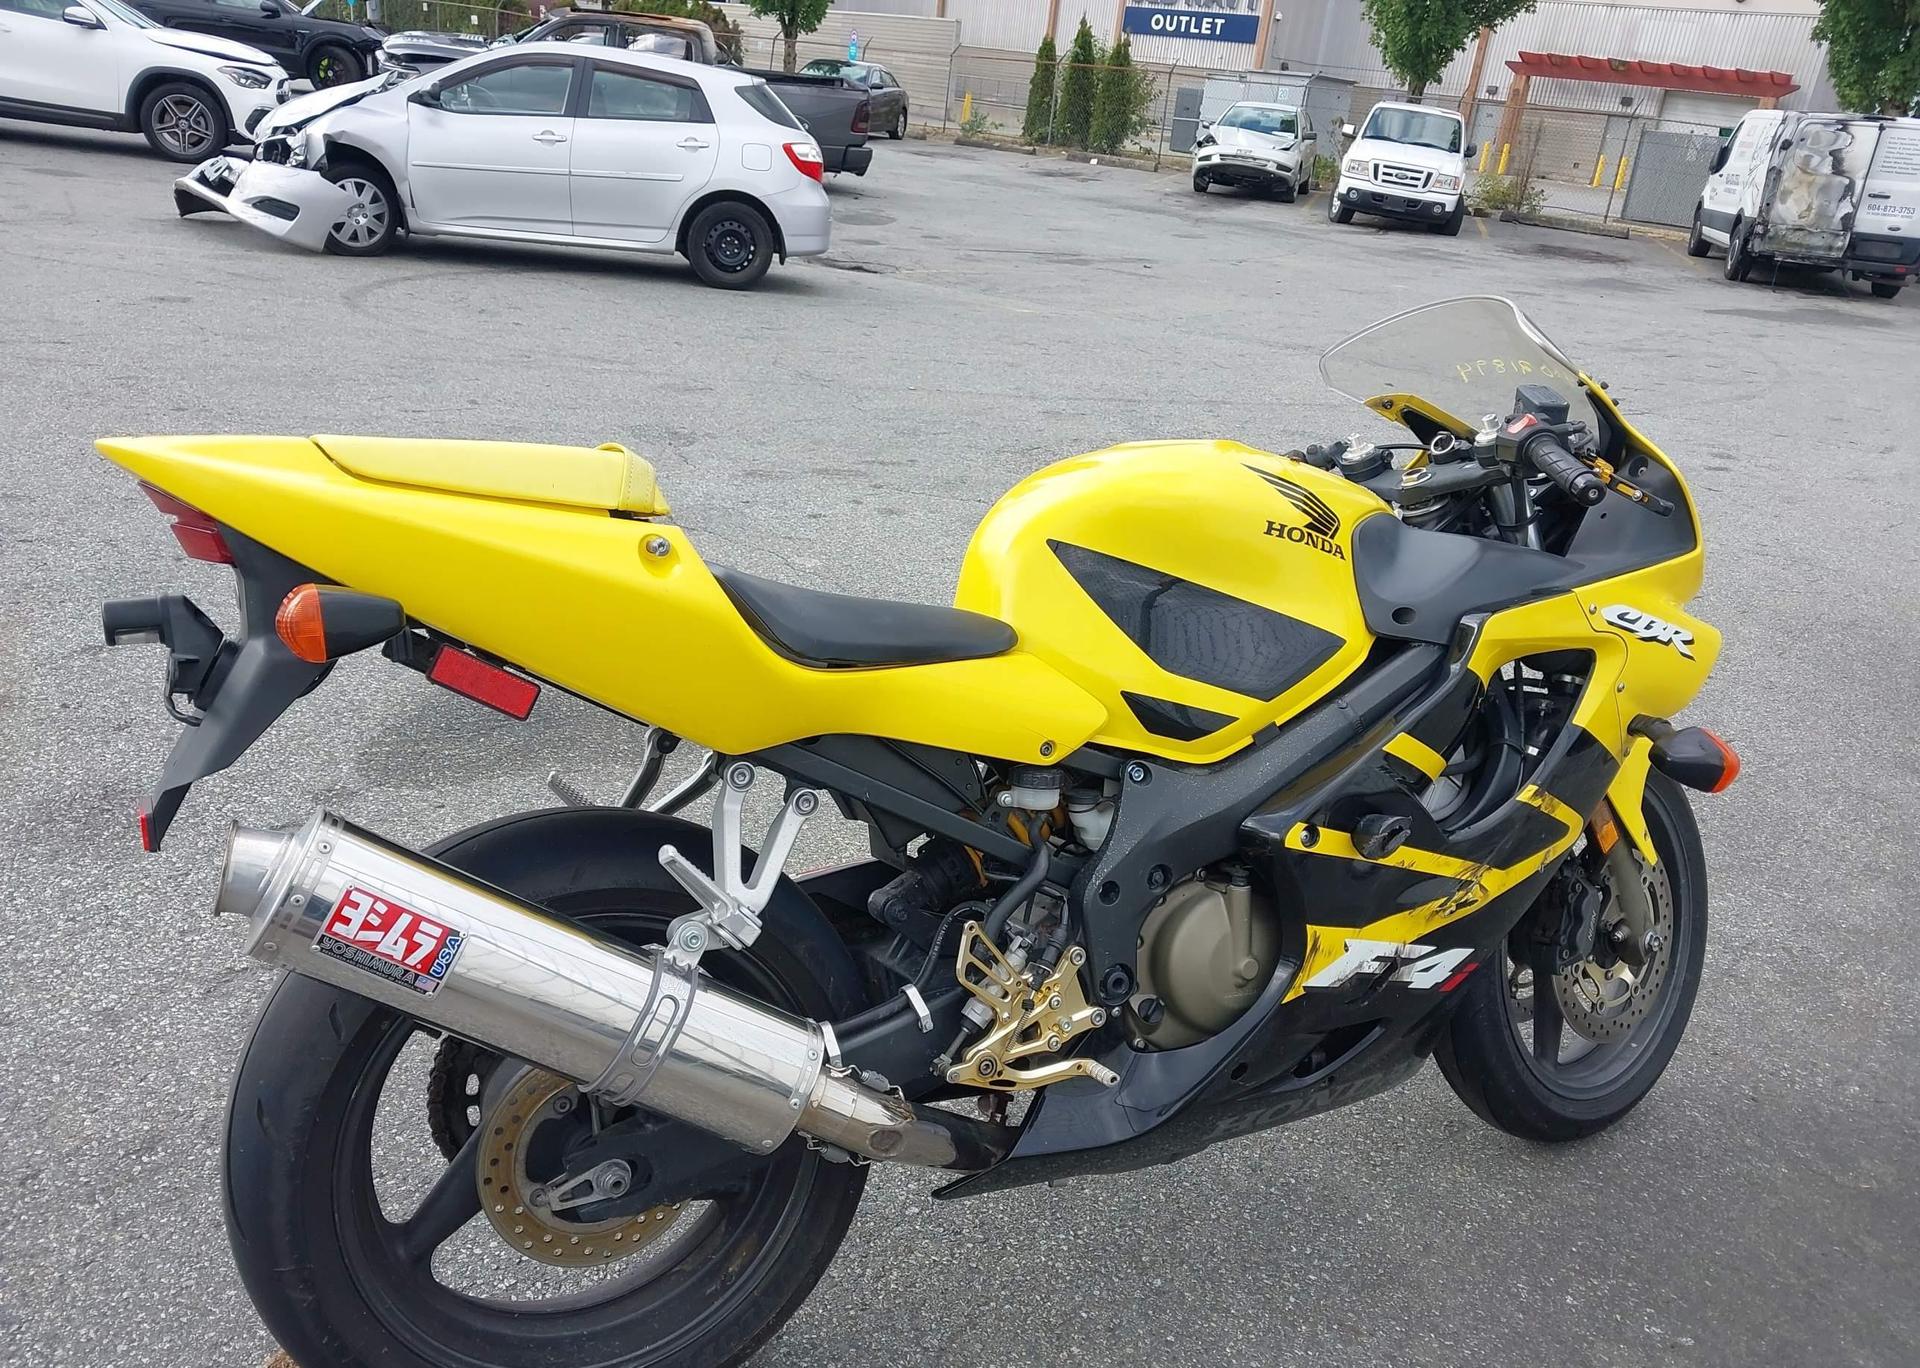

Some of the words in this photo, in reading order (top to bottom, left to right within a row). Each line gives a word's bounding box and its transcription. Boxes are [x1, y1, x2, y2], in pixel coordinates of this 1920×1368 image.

[1151, 13, 1226, 36] OUTLET
[1867, 203, 1916, 215] 604-873-3753
[1263, 519, 1347, 561] HONDA
[1601, 604, 1696, 662] CBR
[331, 889, 444, 967] ヨシムラ
[320, 936, 416, 985] YOSHIMURA
[430, 935, 462, 978] USA
